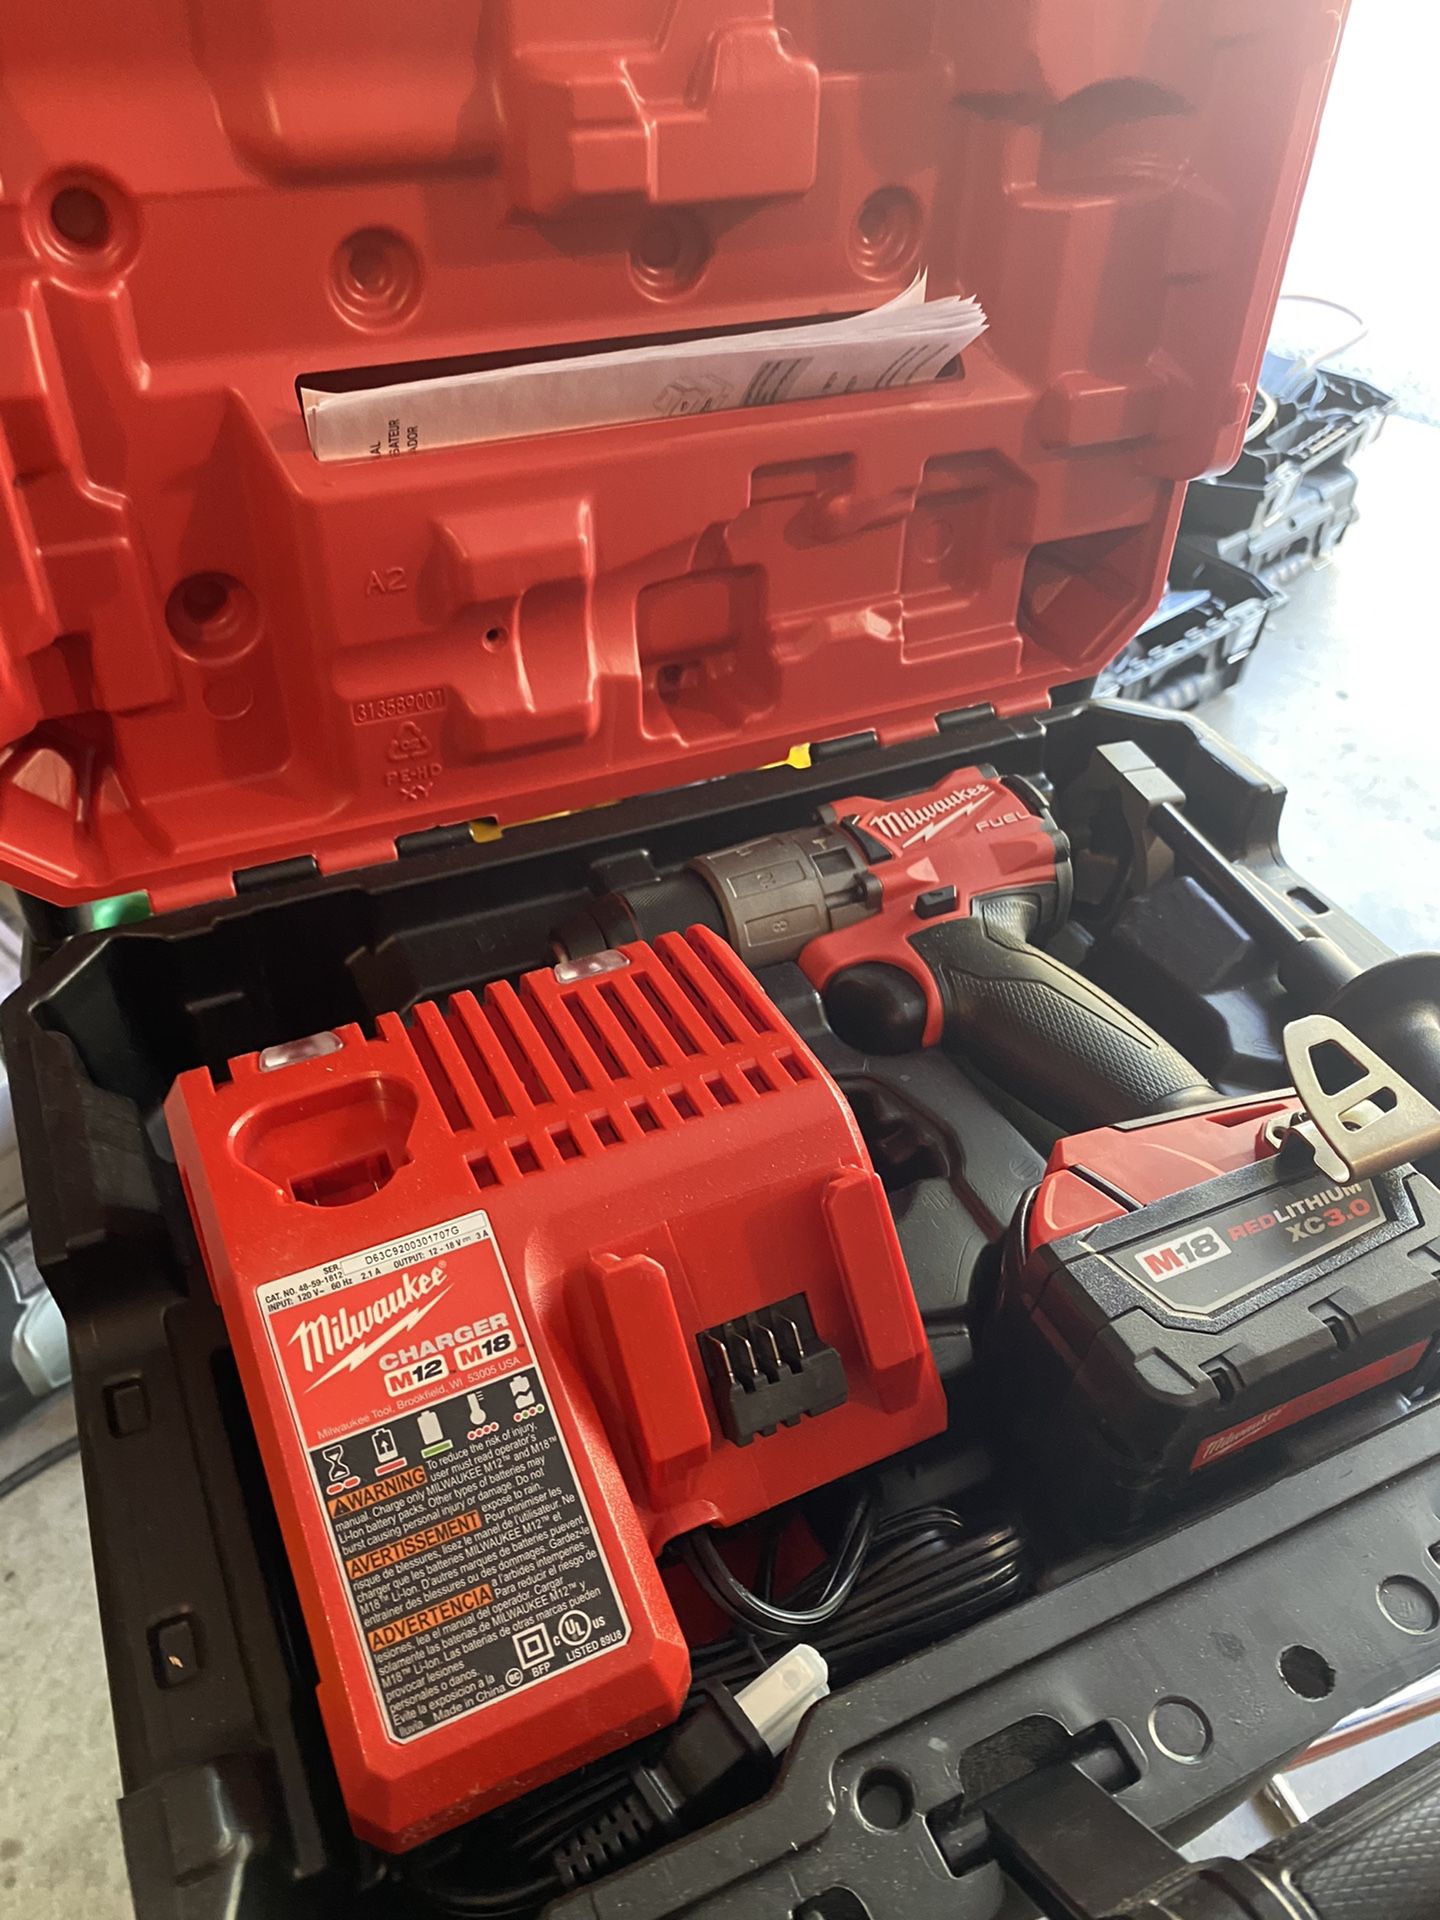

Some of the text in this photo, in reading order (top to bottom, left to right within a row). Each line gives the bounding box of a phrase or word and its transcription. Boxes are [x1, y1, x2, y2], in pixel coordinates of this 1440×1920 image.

[366, 567, 408, 595] A2
[356, 689, 442, 722] 313589001
[385, 763, 442, 787] PE-HD
[399, 781, 434, 801] XY
[868, 782, 990, 838] Milwaukee
[976, 812, 1032, 833] FUEL
[1227, 1183, 1362, 1243] REDLITHIUM
[1284, 1198, 1371, 1243] XC3.0
[266, 1229, 489, 1312] INPUT: 120 60 Hz 2.1 A OUTPUT: 12 18 3 A
[322, 1263, 339, 1275] SER.
[364, 1225, 459, 1265] D63C9200301707G
[1142, 1232, 1221, 1277] M18
[264, 1270, 343, 1304] CAT. NO. 48-59-1812
[288, 1266, 447, 1372] Milwaukee
[378, 1312, 509, 1371] CHARGER
[387, 1332, 514, 1393] M12 M18
[316, 1414, 369, 1440] Milwaukee
[395, 1383, 448, 1410] Brookfield,
[466, 1364, 497, 1383] 53005
[497, 1355, 521, 1371] USA
[425, 1421, 538, 1470] To reduce the risk of injury,
[429, 1432, 537, 1482] user must read operator's
[1203, 1407, 1283, 1459] Milwaukee
[334, 1446, 530, 1536] manual. Charge only MILWAUKEE and
[340, 1466, 545, 1556] burst causing personal injury or damage. Do not
[345, 1467, 426, 1512] WARNING
[364, 1514, 396, 1533] battery
[395, 1503, 427, 1523] packs.
[426, 1491, 452, 1508] Other
[452, 1482, 478, 1499] types
[478, 1475, 488, 1488] of
[487, 1462, 526, 1484] batteries
[525, 1454, 545, 1468] may
[480, 1482, 544, 1512] expose to rain.
[483, 1486, 562, 1524] Pour minimiser les
[350, 1510, 477, 1578] AVERTISSEMENT
[352, 1573, 381, 1591] risque
[381, 1567, 395, 1579] de
[394, 1549, 442, 1574] blessures,
[440, 1539, 463, 1554] lisez
[462, 1535, 473, 1545] le
[500, 1518, 513, 1530] de
[560, 1493, 575, 1505] Ne
[355, 1510, 562, 1603] charger que les batteries MILWAUKEE et
[420, 1567, 459, 1590] D'autres
[458, 1551, 498, 1574] marques
[498, 1546, 511, 1557] de
[510, 1530, 549, 1552] batteries
[404, 1596, 423, 1610] des
[421, 1577, 466, 1602] blessures
[466, 1572, 480, 1584] ou
[479, 1565, 497, 1578] des
[497, 1544, 548, 1571] dommages.
[493, 1548, 597, 1599] Para reducir el riesgo de
[372, 1586, 492, 1650] ADVERTENCIA
[377, 1580, 585, 1676] solamente las de MILWAUKEE y
[414, 1633, 431, 1646] lea
[431, 1626, 441, 1639] el
[441, 1611, 476, 1634] manual
[475, 1605, 491, 1620] del
[490, 1589, 533, 1614] operador.
[533, 1575, 563, 1595] Cargar
[442, 1647, 462, 1661] Las
[498, 1625, 511, 1637] de
[511, 1615, 535, 1632] otras
[534, 1601, 568, 1621] marcas
[567, 1586, 601, 1609] pueden
[590, 1614, 607, 1630] US
[529, 1659, 553, 1679] BFP
[564, 1637, 601, 1663] LISTED
[384, 1659, 465, 1703] provocar lesiones
[388, 1681, 448, 1716] personales o
[391, 1674, 495, 1726] Evite la a la
[431, 1683, 506, 1722] Made in China
